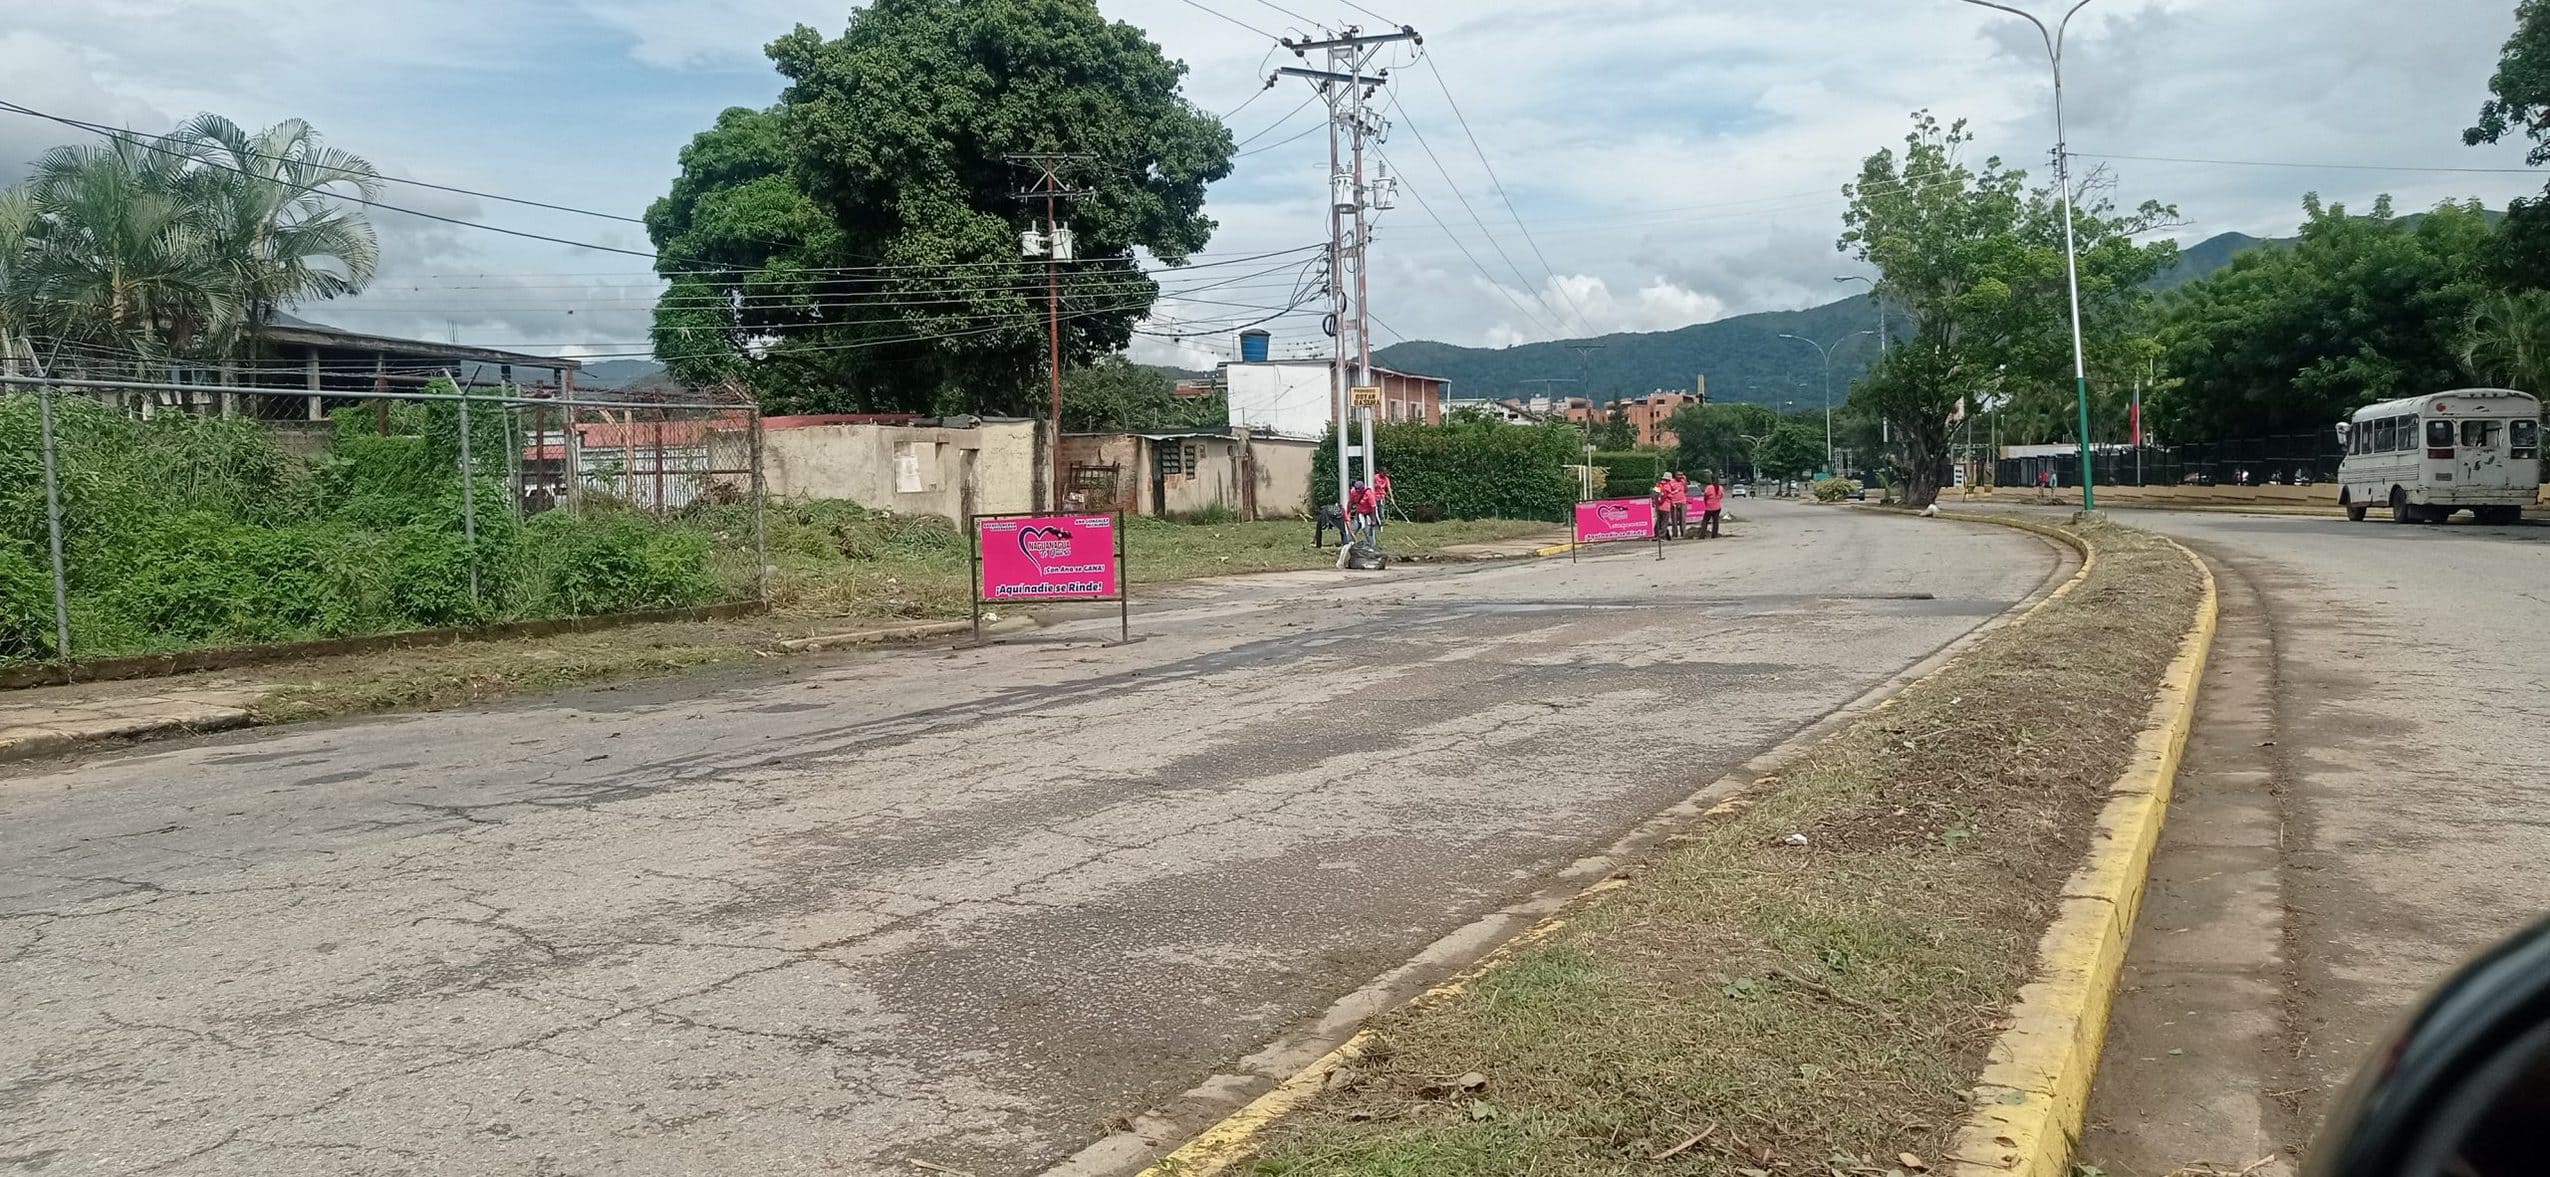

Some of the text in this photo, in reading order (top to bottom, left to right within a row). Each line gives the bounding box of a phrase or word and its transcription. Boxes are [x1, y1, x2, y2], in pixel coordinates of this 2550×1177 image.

[1029, 541, 1070, 550] NAGUANAGUA
[996, 583, 1023, 595] ¡Aquí
[1024, 582, 1053, 593] nadie
[1068, 582, 1102, 592] Rinde!
